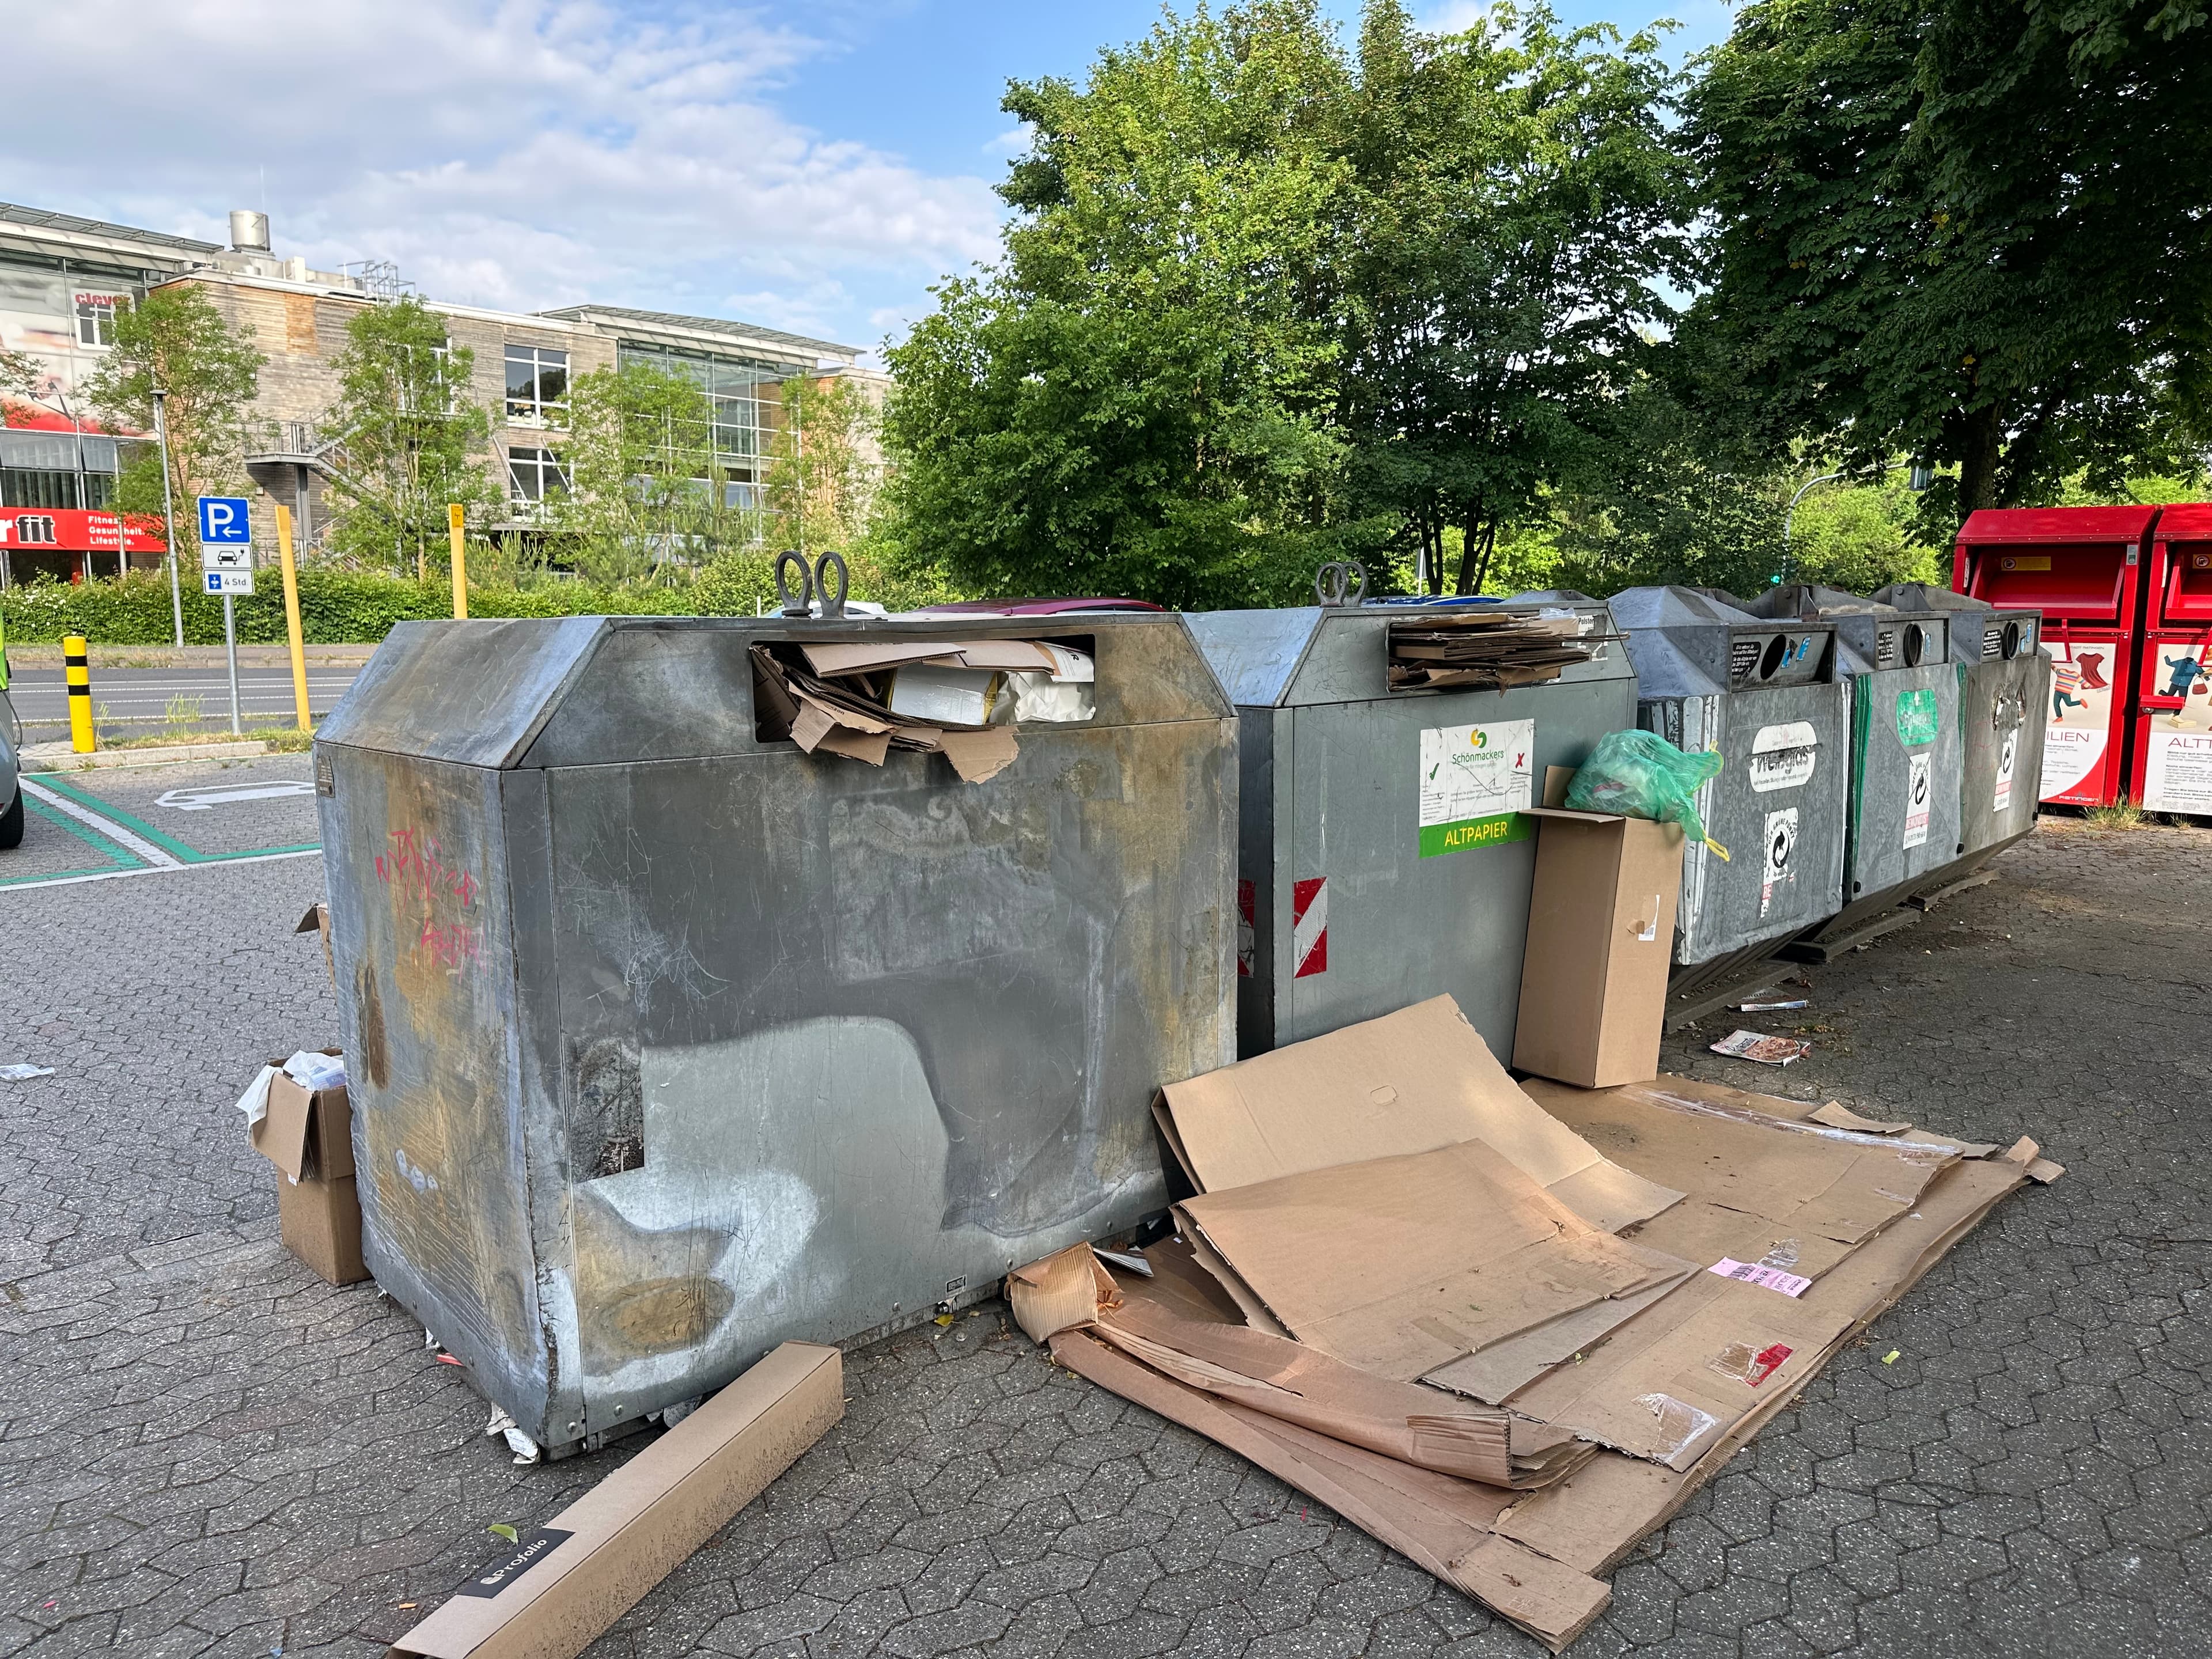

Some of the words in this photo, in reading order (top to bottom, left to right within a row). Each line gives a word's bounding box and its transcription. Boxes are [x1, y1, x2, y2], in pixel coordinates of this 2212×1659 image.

[207, 503, 234, 537] P
[16, 514, 56, 544] fit
[89, 526, 145, 535] Gesunheit.
[90, 536, 135, 545] Lifestle.
[225, 578, 230, 586] 4
[1452, 749, 1504, 764] Schönmackers
[1444, 821, 1508, 847] ALTPAPIER
